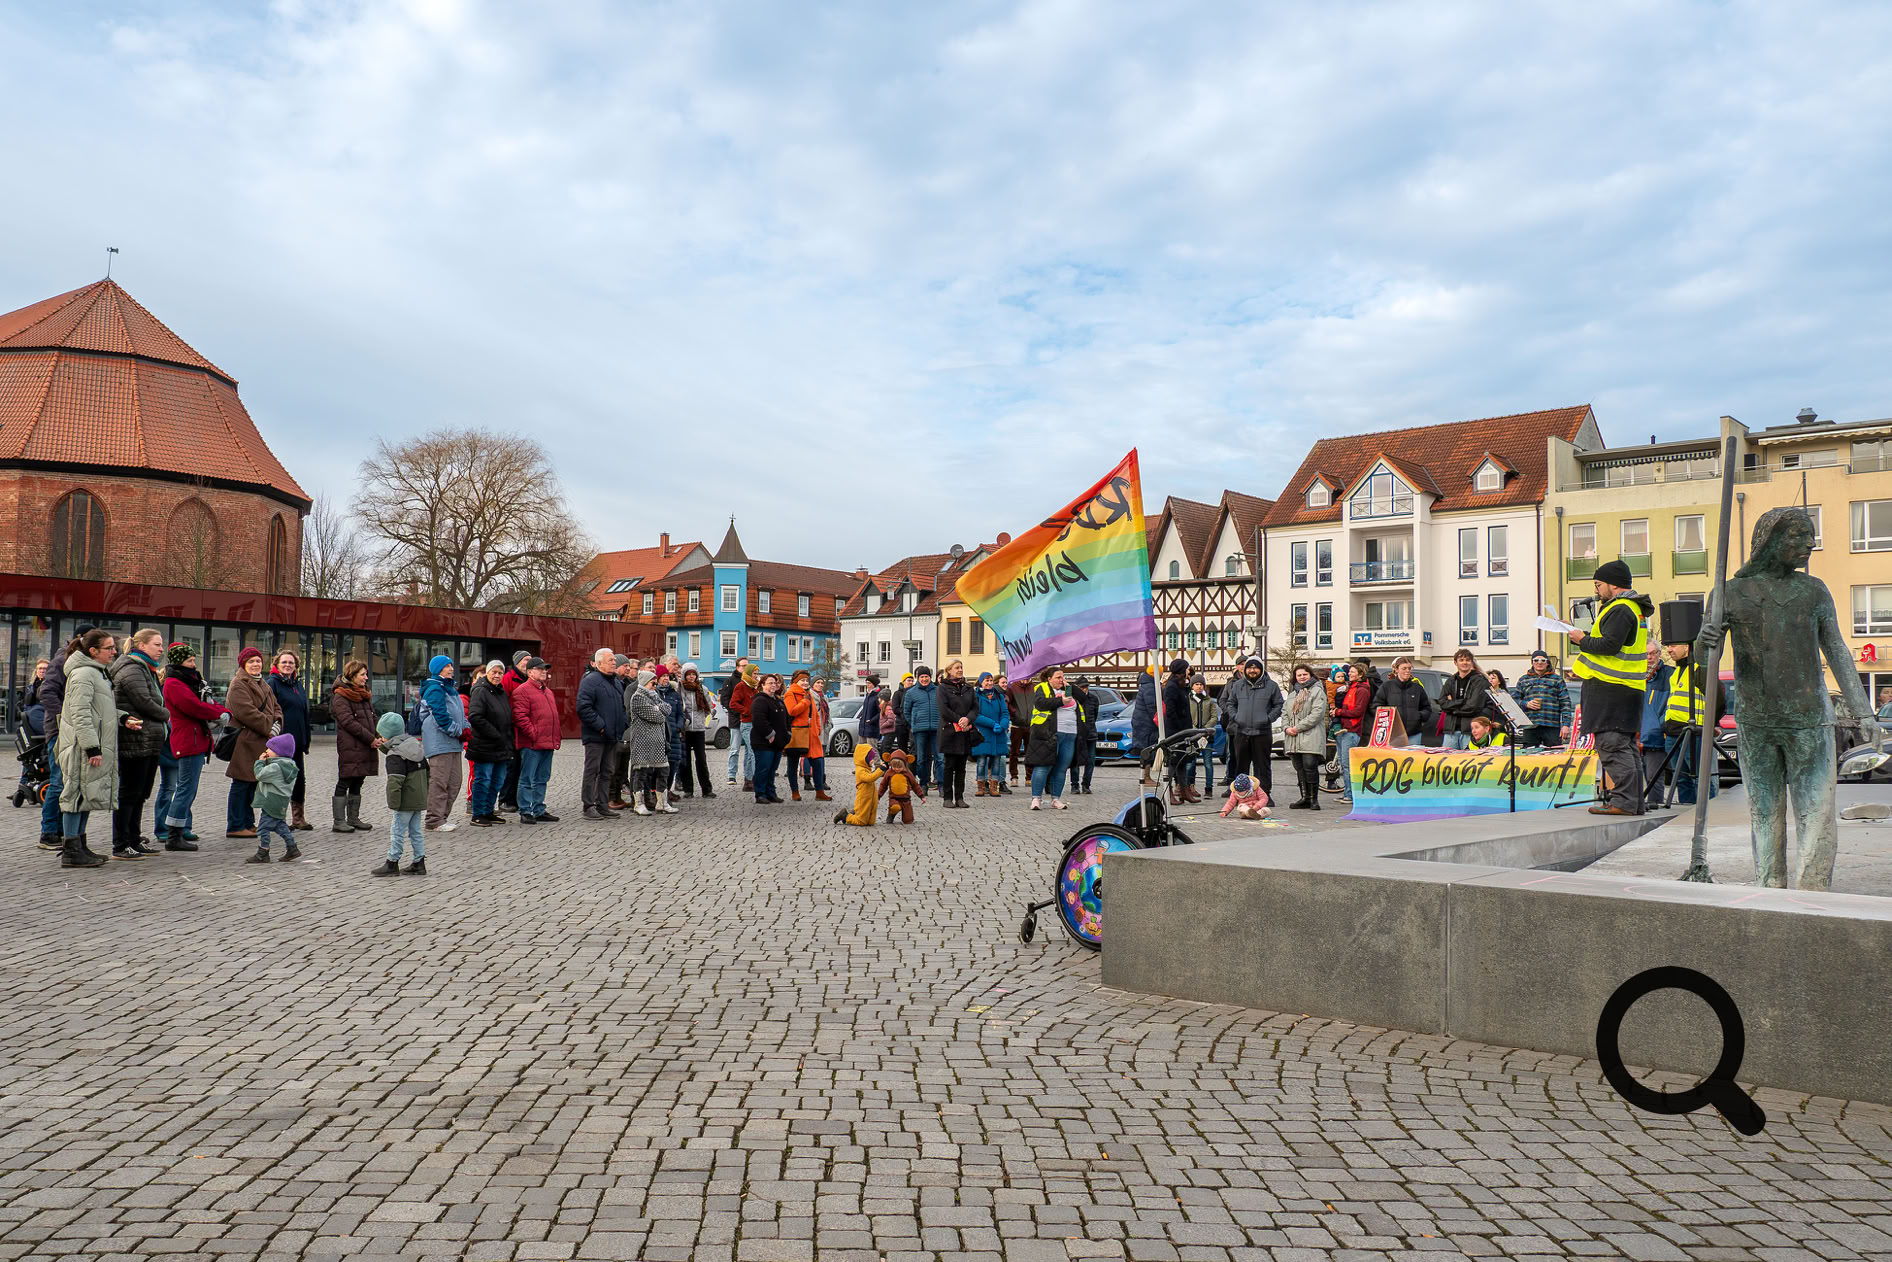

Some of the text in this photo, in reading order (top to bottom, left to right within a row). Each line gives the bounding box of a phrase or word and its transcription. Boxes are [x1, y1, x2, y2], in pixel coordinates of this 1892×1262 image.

[1360, 755, 1592, 800] RDG bleibt bunt!
